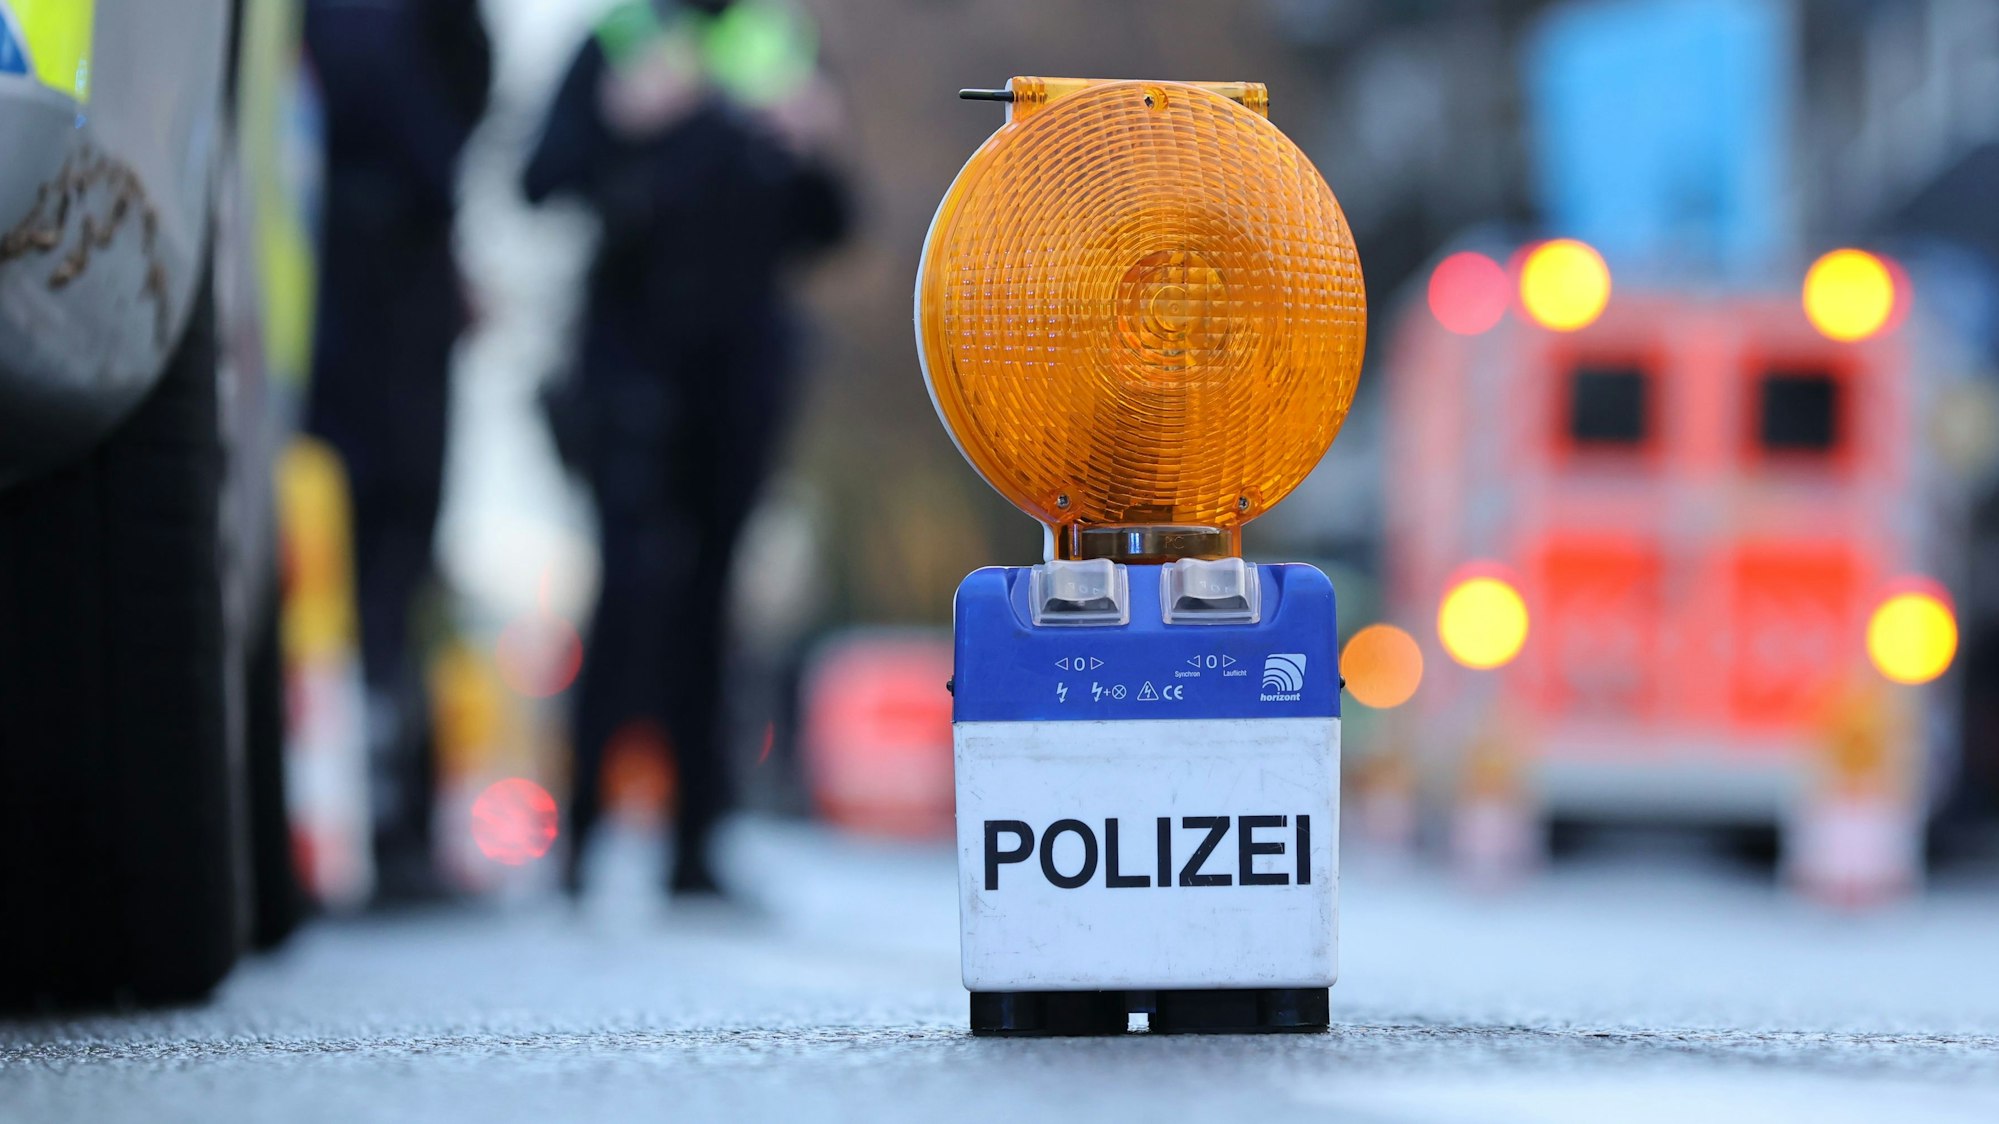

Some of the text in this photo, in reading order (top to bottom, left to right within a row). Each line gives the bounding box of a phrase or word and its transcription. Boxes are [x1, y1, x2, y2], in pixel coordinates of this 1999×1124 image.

[1174, 670, 1201, 679] Synchron
[1223, 669, 1247, 677] Lauflicht
[1162, 684, 1184, 700] CE
[1260, 692, 1301, 702] horizont
[984, 814, 1311, 891] POLIZEI
